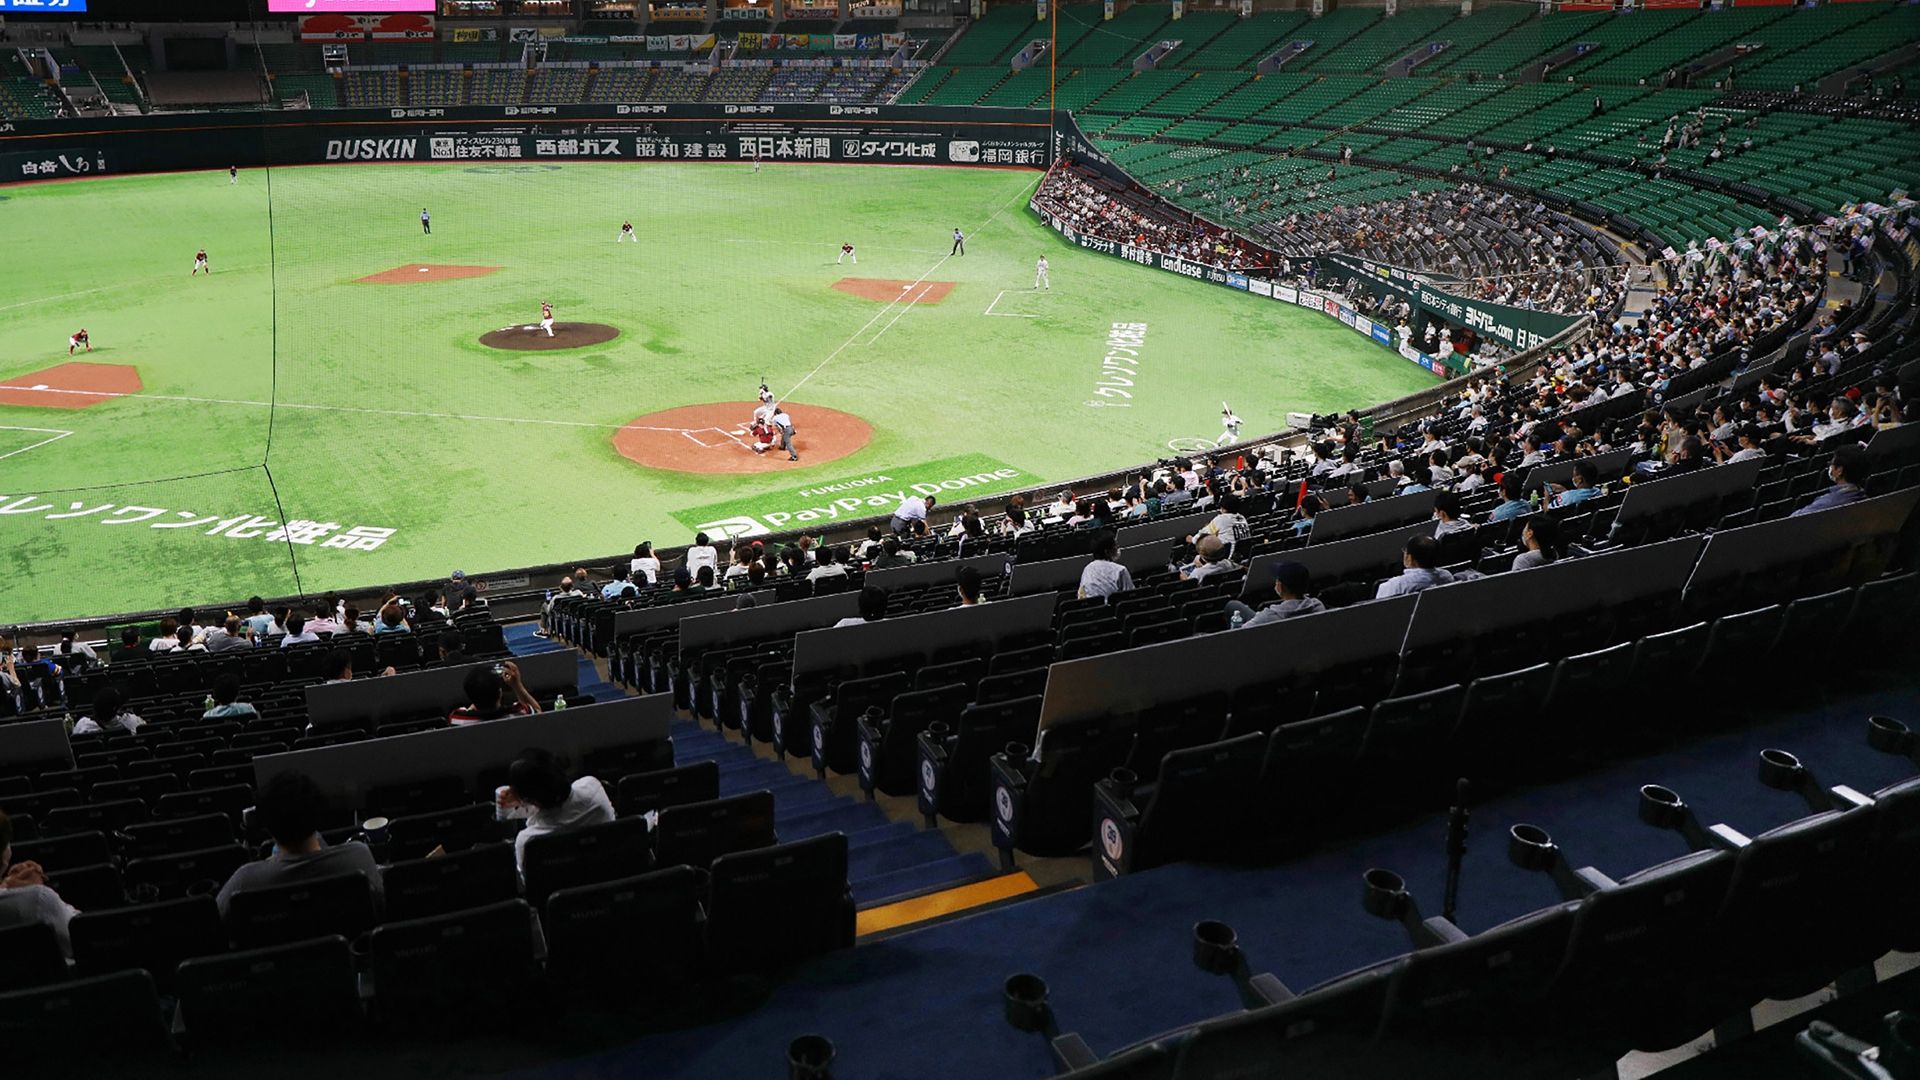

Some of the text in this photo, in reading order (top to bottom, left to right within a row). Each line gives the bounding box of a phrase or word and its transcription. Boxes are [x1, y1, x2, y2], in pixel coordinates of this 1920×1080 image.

[326, 138, 417, 160] DUSKIN
[455, 145, 522, 158] 住友不動産
[535, 139, 621, 156] 西部ガス
[636, 143, 727, 158] 昭和建設
[739, 137, 831, 158] 西日本新聞
[861, 141, 936, 158] ダイワ化成
[982, 149, 1044, 164] 福岡銀行
[1421, 290, 1463, 319] 西日本シティ銀行
[799, 475, 893, 498] FUKUOKA
[762, 468, 1021, 527] PayPay Dome
